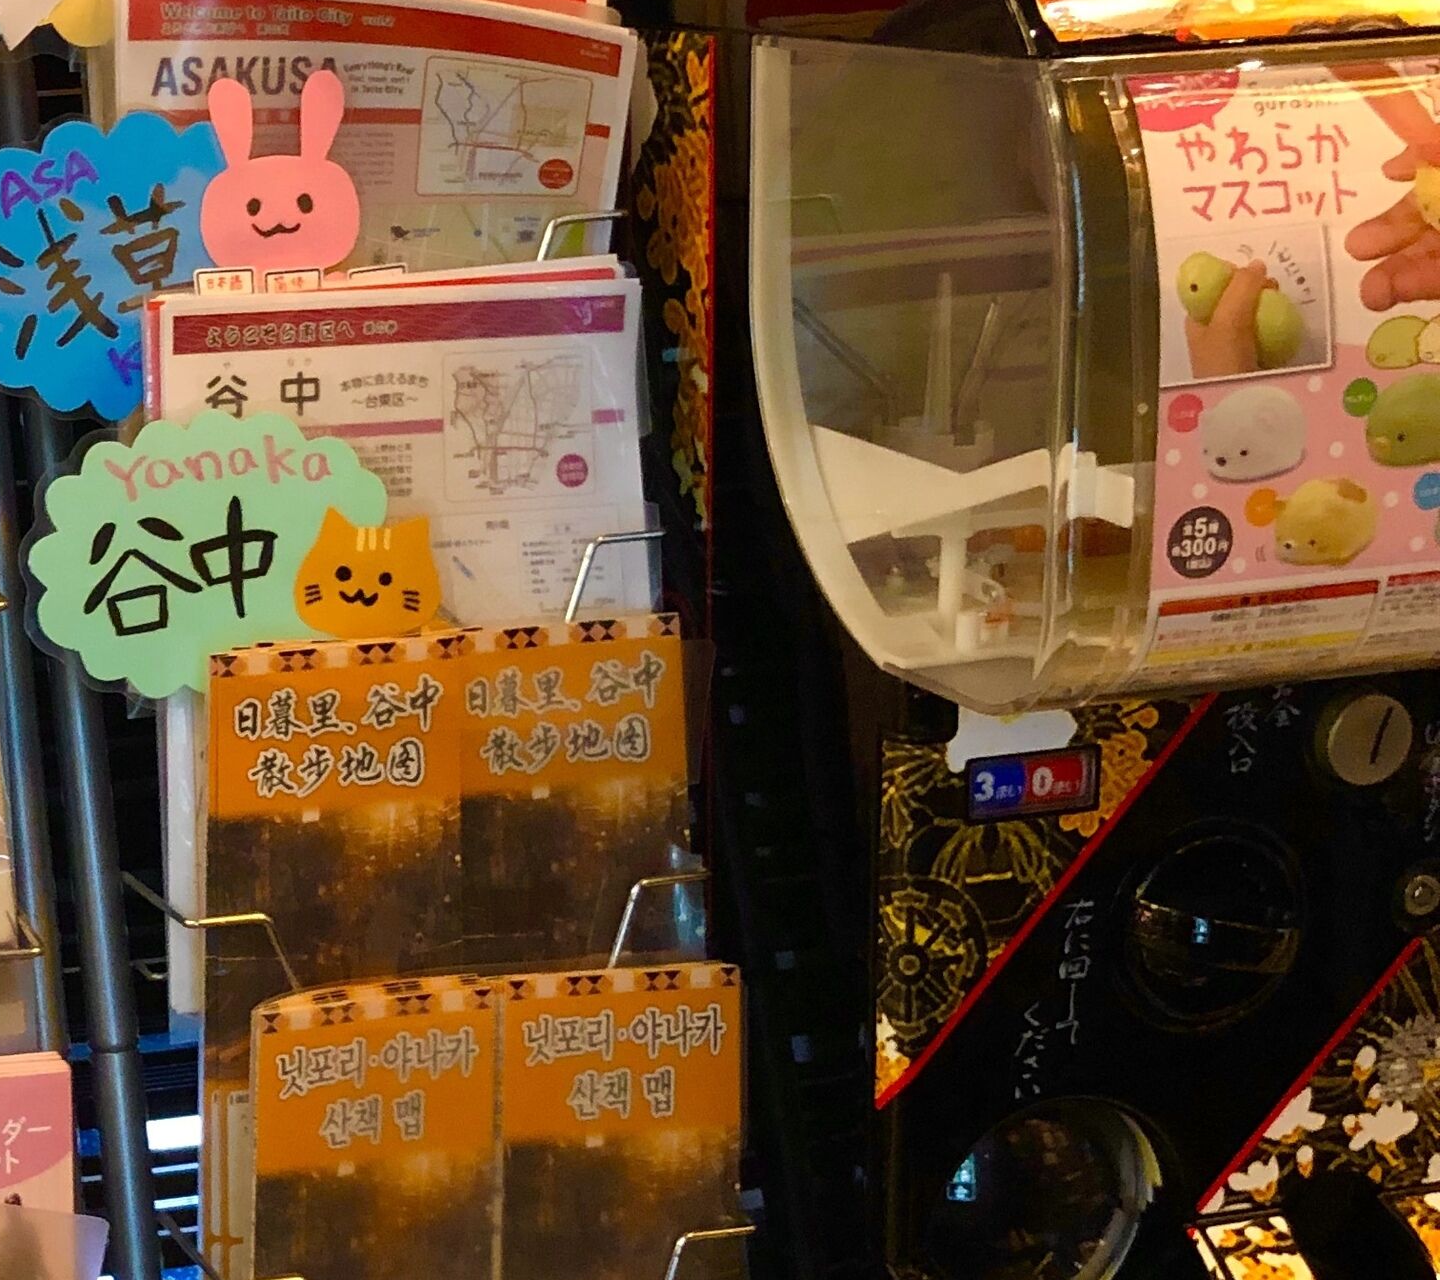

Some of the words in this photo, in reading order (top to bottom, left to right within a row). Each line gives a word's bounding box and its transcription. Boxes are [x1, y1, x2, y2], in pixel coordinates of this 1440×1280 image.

[1175, 121, 1351, 175] やわらか
[1181, 170, 1358, 221] マスコット
[205, 320, 356, 348] ようこそ台東区へ
[204, 371, 321, 418] 谷中
[104, 433, 335, 503] Yanaka
[82, 494, 280, 639] 谷中
[566, 1068, 630, 1120] 산책
[641, 1066, 675, 1118] 맵
[319, 1094, 383, 1147] 산책
